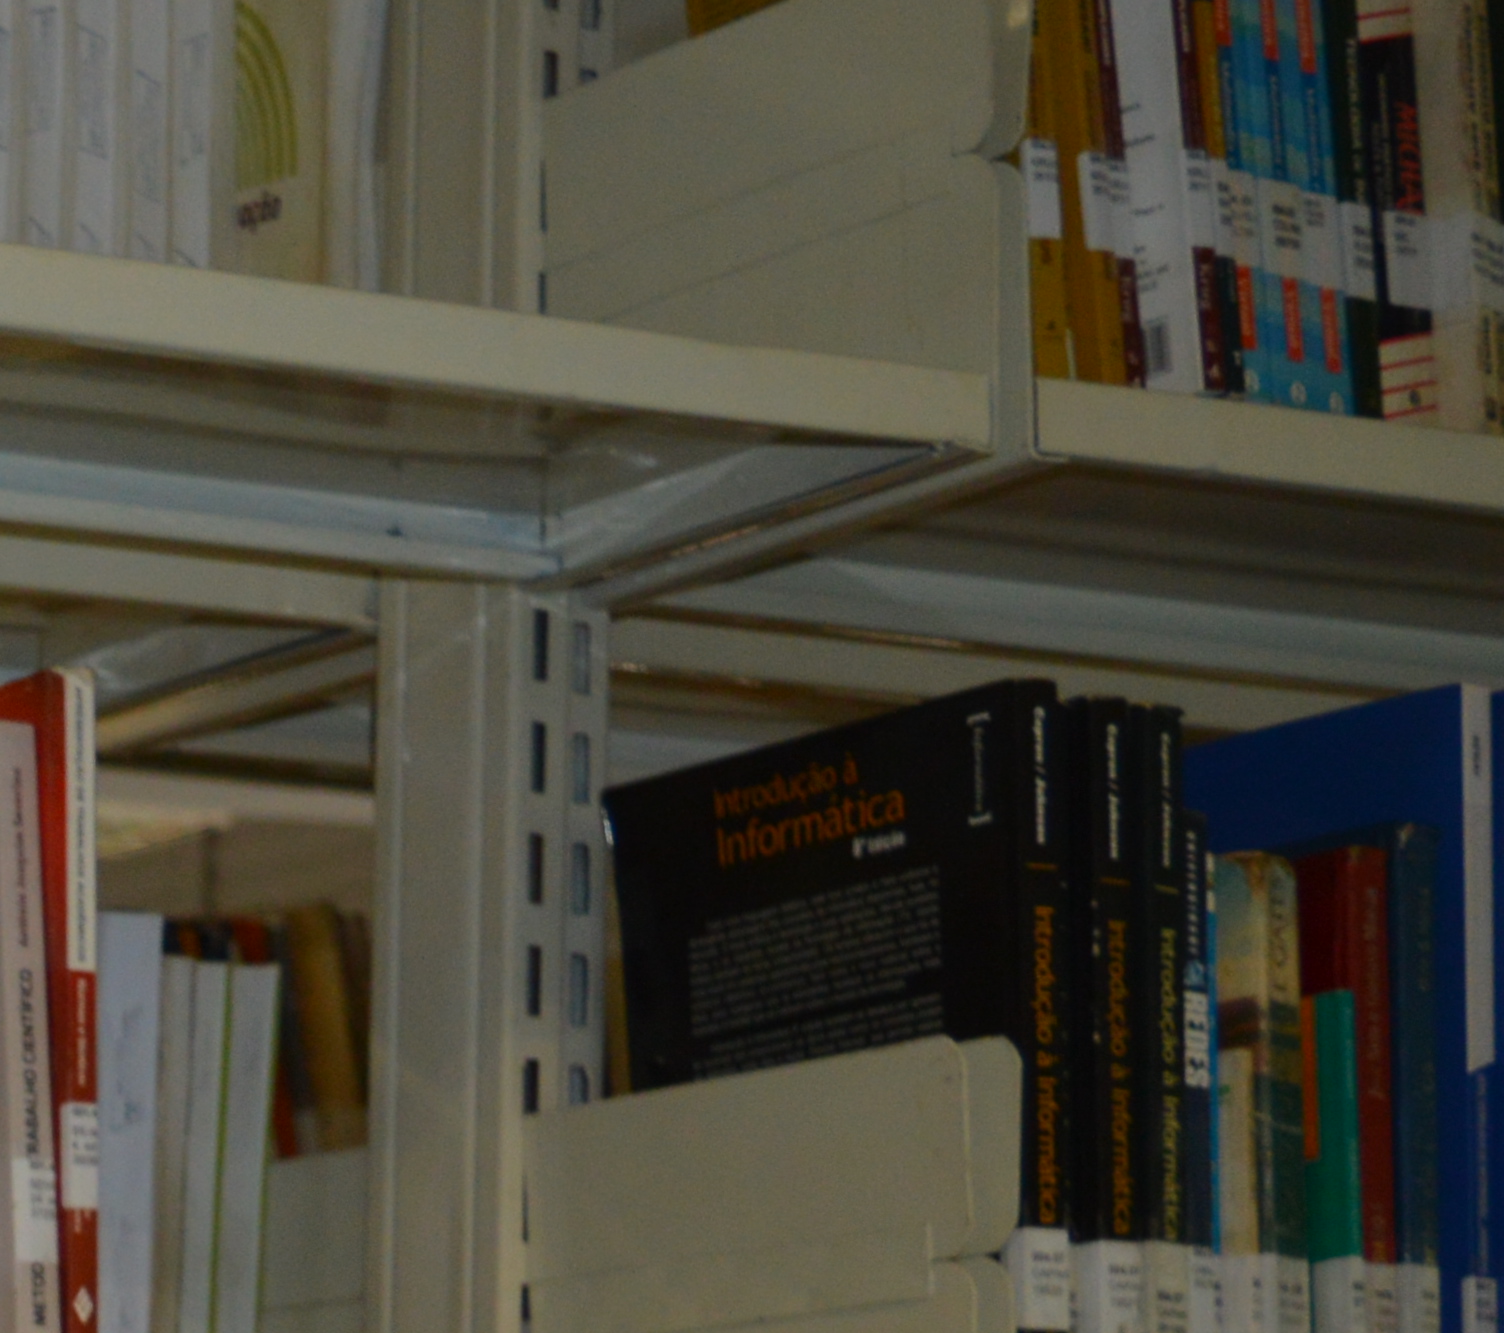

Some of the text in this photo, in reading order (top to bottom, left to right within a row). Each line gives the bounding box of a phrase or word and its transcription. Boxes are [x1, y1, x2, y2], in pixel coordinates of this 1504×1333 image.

[713, 752, 858, 820] Introdução à
[716, 789, 906, 868] Informática
[1033, 905, 1057, 1045] Introdução
